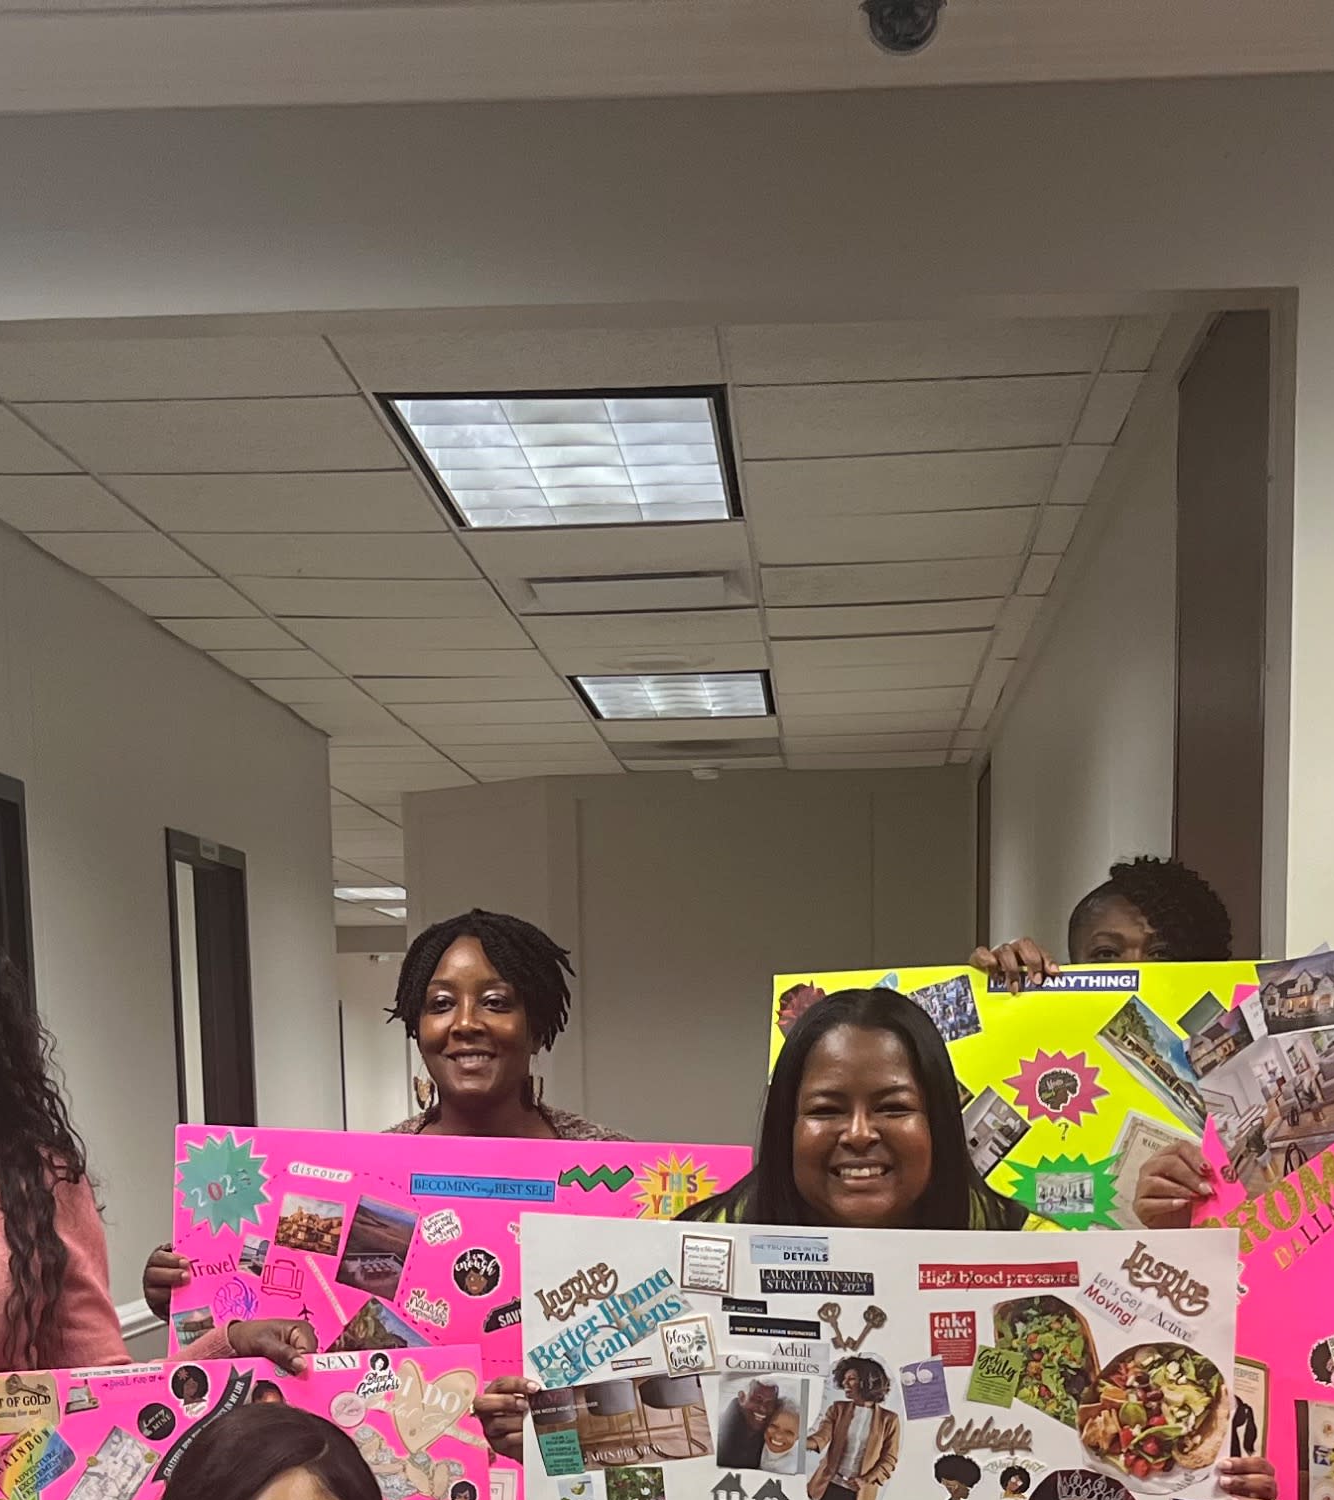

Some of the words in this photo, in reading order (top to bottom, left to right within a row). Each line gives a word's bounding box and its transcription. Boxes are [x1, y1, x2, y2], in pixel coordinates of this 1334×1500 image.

[1042, 974, 1137, 989] ANYTHING!
[291, 1163, 351, 1181] discover
[413, 1178, 479, 1194] BECOMING
[495, 1184, 524, 1194] BEST
[525, 1184, 553, 1197] SELF
[783, 1251, 829, 1262] DETAILS
[189, 1254, 237, 1280] Travel
[455, 1258, 498, 1276] enough
[761, 1269, 809, 1280] LAUNCH
[818, 1272, 873, 1283] WINNING
[919, 1270, 956, 1288] High
[958, 1270, 1004, 1284] blood
[1007, 1271, 1079, 1287] pressure
[766, 1279, 824, 1291] STRATEGY
[825, 1281, 839, 1291] IN
[841, 1282, 867, 1293] 2023
[1092, 1272, 1117, 1296] Let's
[1119, 1288, 1143, 1311] Get
[1083, 1284, 1138, 1327] Moving!
[527, 1313, 598, 1373] Better
[596, 1267, 674, 1326] Home
[934, 1314, 972, 1329] take
[666, 1327, 692, 1345] bless
[933, 1328, 972, 1340] care
[772, 1342, 812, 1358] Adult
[315, 1356, 359, 1371] SEXY
[669, 1353, 701, 1369] house
[725, 1354, 820, 1374] Communities
[5, 1395, 20, 1408] OF
[21, 1393, 52, 1407] GOLD
